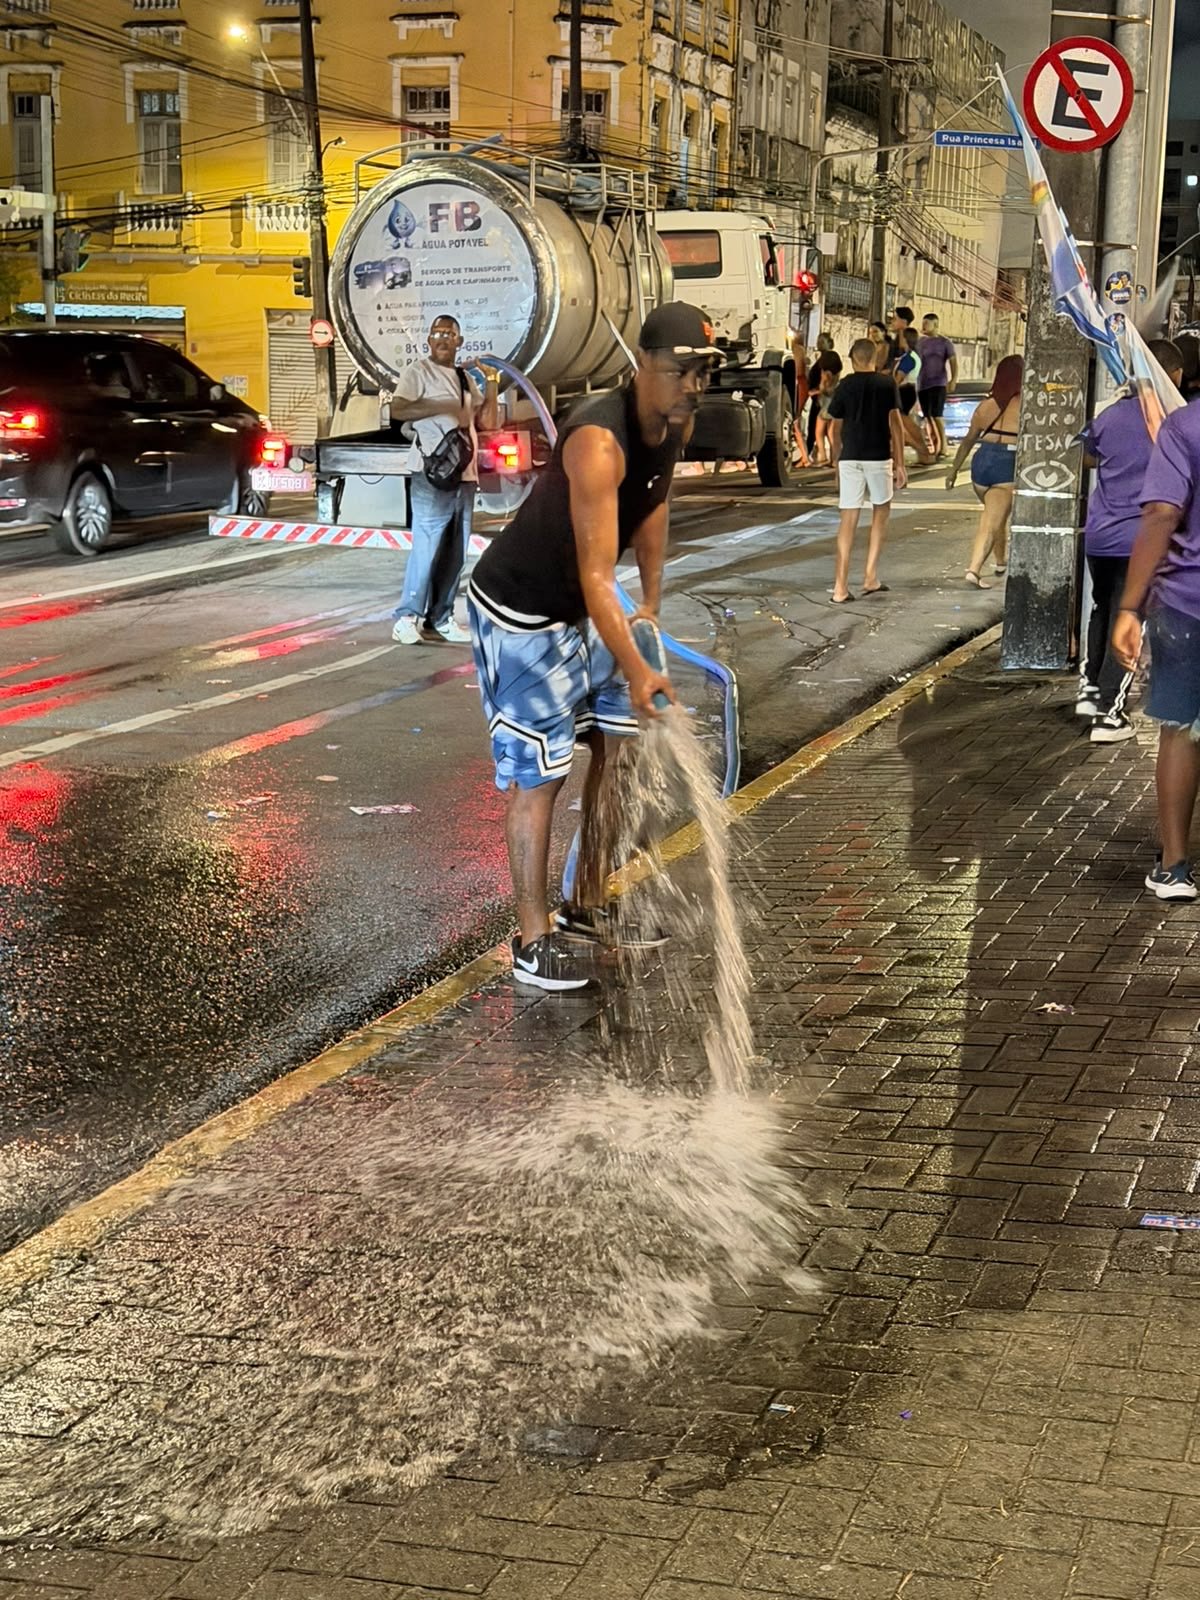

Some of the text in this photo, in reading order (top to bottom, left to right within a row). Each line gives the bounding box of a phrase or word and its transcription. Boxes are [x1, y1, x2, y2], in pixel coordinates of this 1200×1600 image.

[1051, 58, 1110, 131] E
[942, 134, 1037, 146] Rua Princesa Isal
[428, 201, 482, 233] FB
[464, 265, 511, 273] TRANSPORTE
[405, 343, 418, 354] 81
[1024, 368, 1083, 383] PURA
[1023, 412, 1076, 427] PURO
